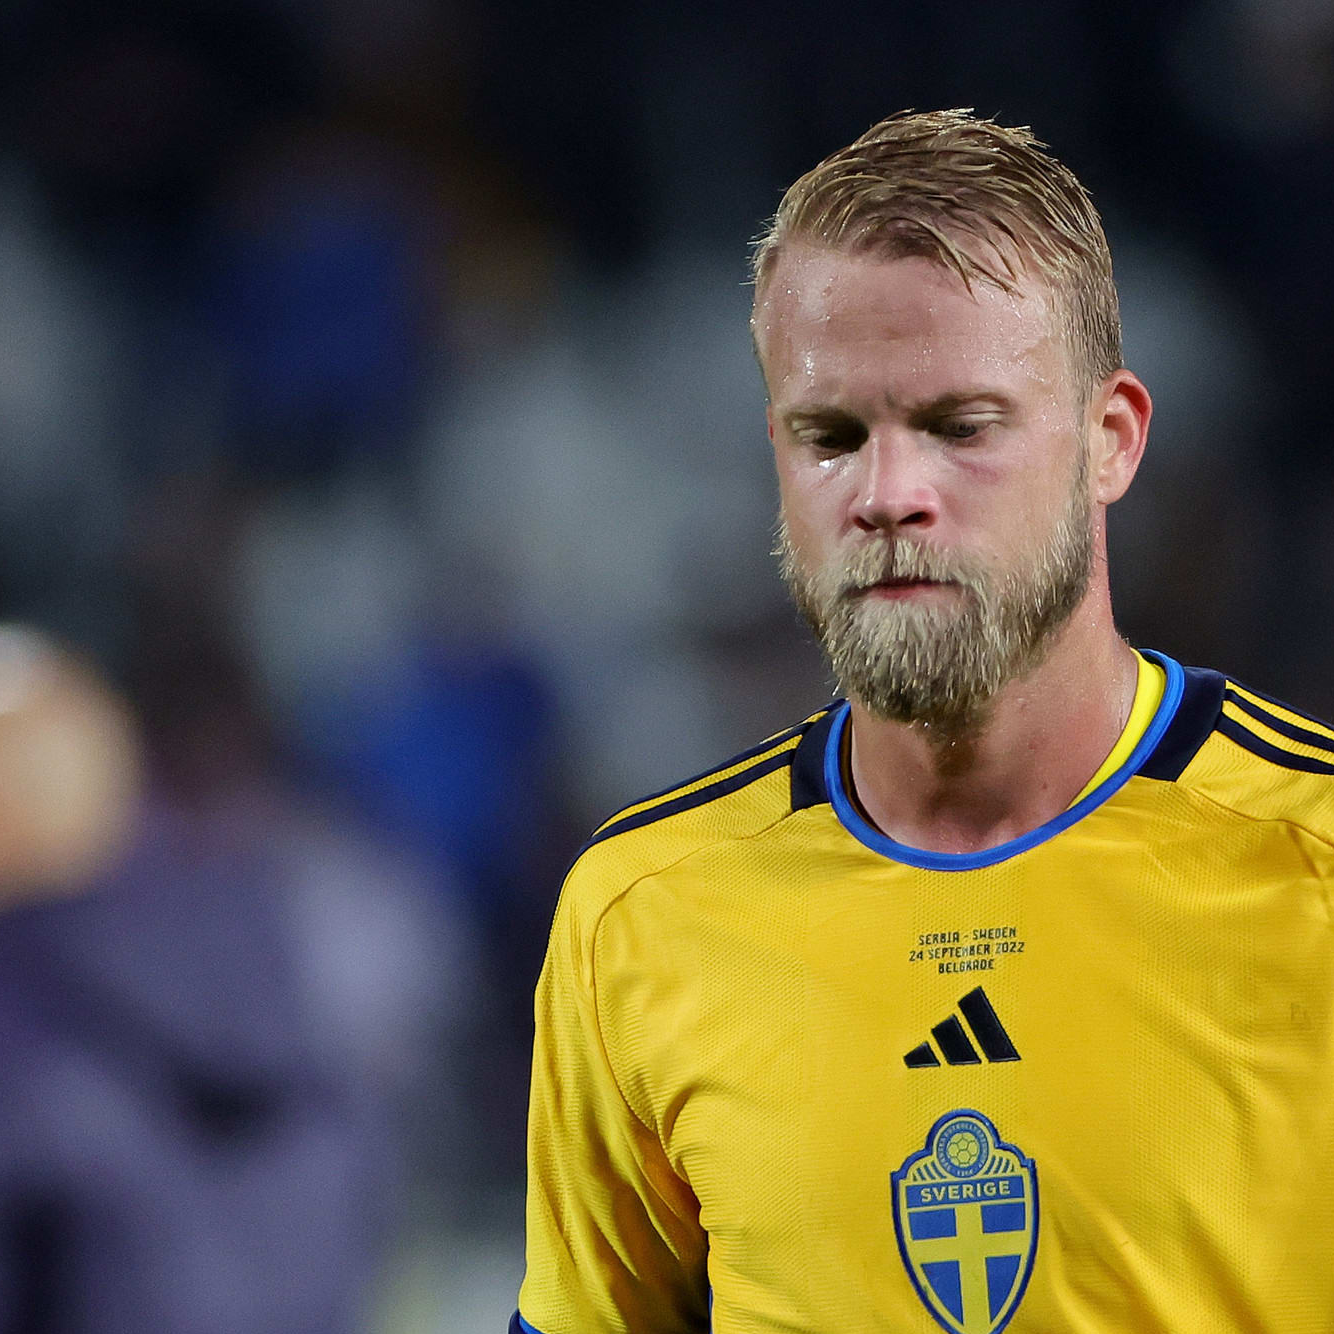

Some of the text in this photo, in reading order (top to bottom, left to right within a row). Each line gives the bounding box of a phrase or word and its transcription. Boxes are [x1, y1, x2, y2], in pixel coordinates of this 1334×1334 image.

[918, 931, 960, 946] SERBIA
[972, 927, 1017, 940] SWEDEN
[909, 941, 1025, 962] 24 SEPTEMBER 2022
[920, 1182, 1011, 1203] SVERIGE
